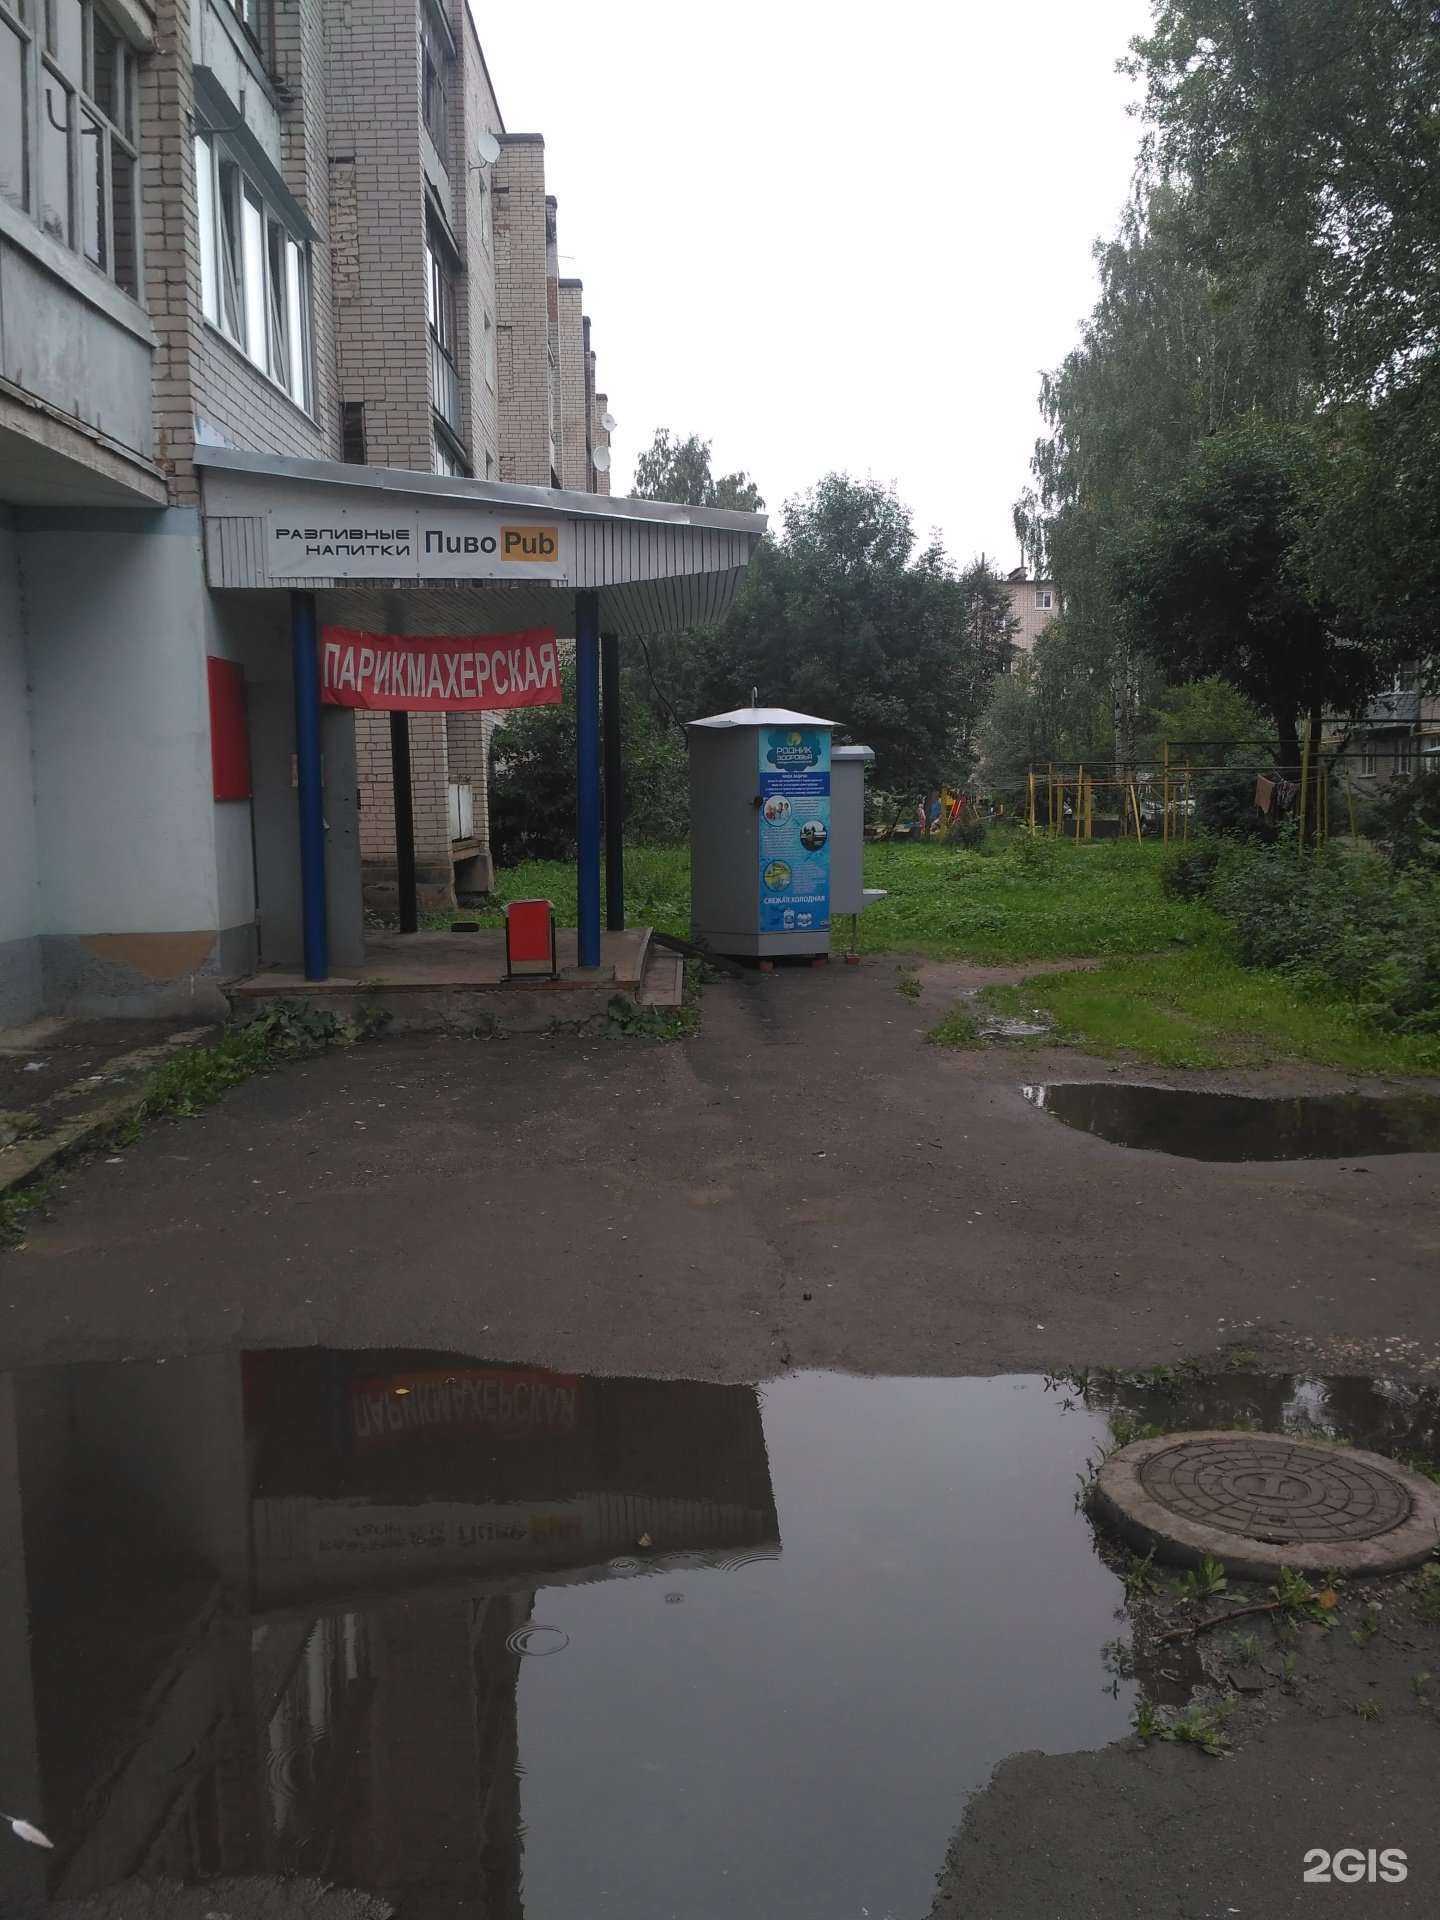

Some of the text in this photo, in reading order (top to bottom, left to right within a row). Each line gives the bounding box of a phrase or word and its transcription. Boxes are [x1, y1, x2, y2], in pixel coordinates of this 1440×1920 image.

[275, 529, 410, 540] РАЗЛИВНЫЕ
[425, 530, 555, 555] Пиво Pub
[305, 545, 410, 556] НАПИТКИ
[323, 643, 558, 699] ПАРИКМАХЕРСКАЯ
[776, 746, 812, 754] РОДНИК
